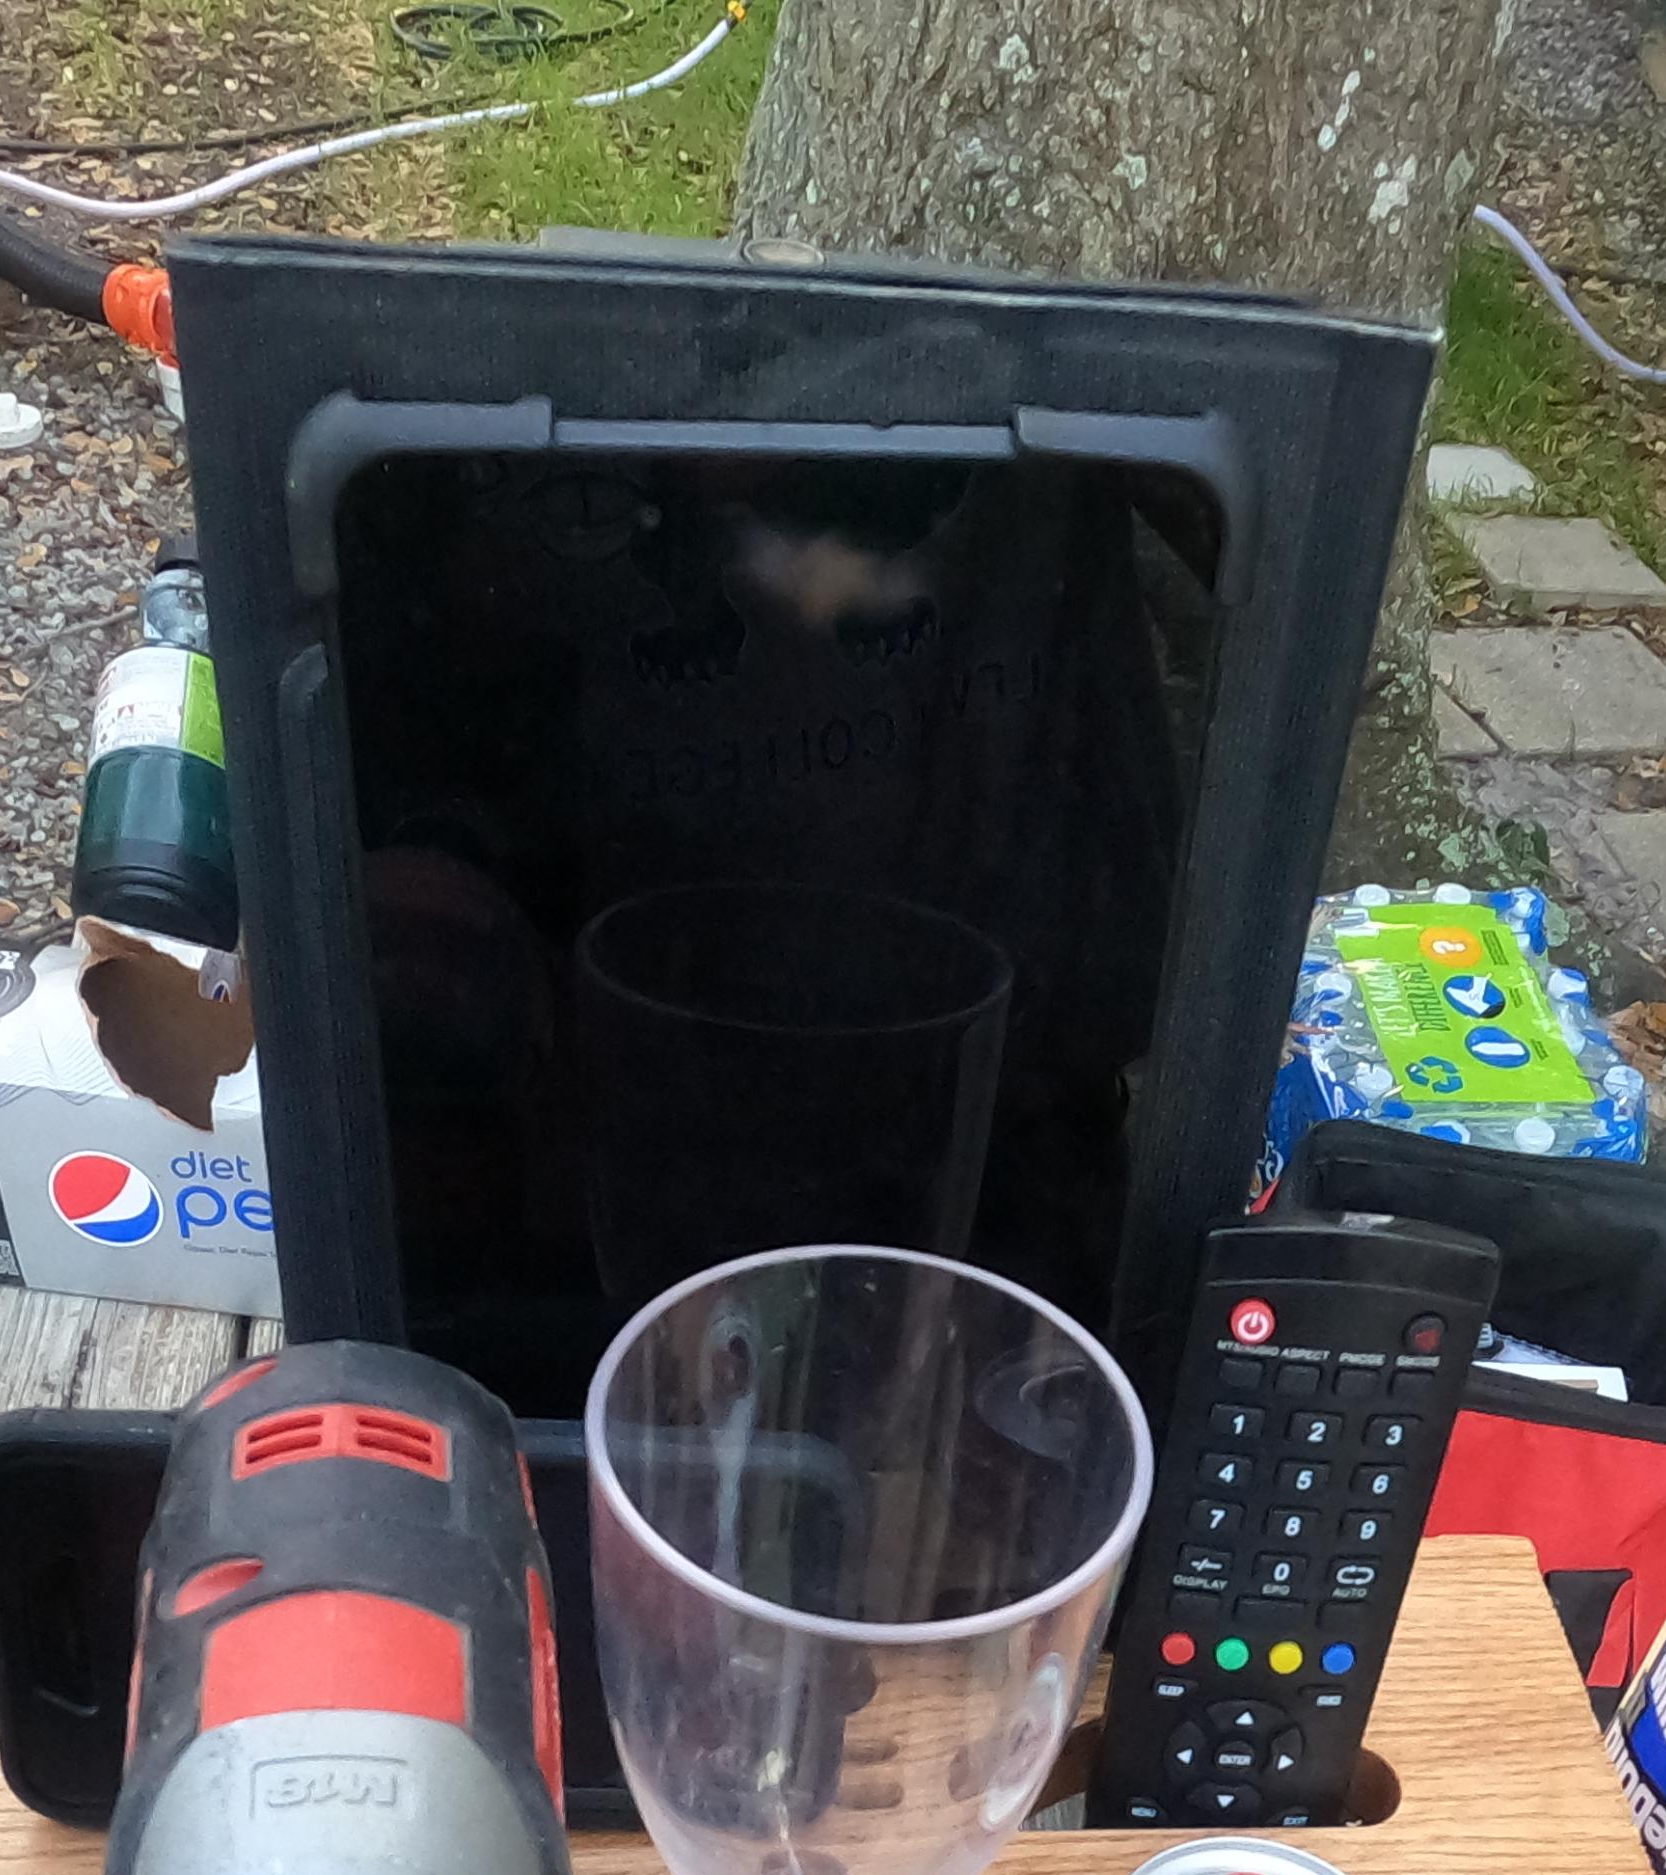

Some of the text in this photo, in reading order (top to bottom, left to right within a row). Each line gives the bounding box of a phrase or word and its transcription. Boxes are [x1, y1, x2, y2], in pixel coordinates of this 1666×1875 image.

[171, 1151, 252, 1182] diet
[176, 1185, 276, 1239] pe
[1233, 1414, 1402, 1446] 1 2 3
[1218, 1463, 1390, 1495] 4 5 6
[1210, 1509, 1377, 1541] 7 8 9
[1274, 1562, 1290, 1582] 0
